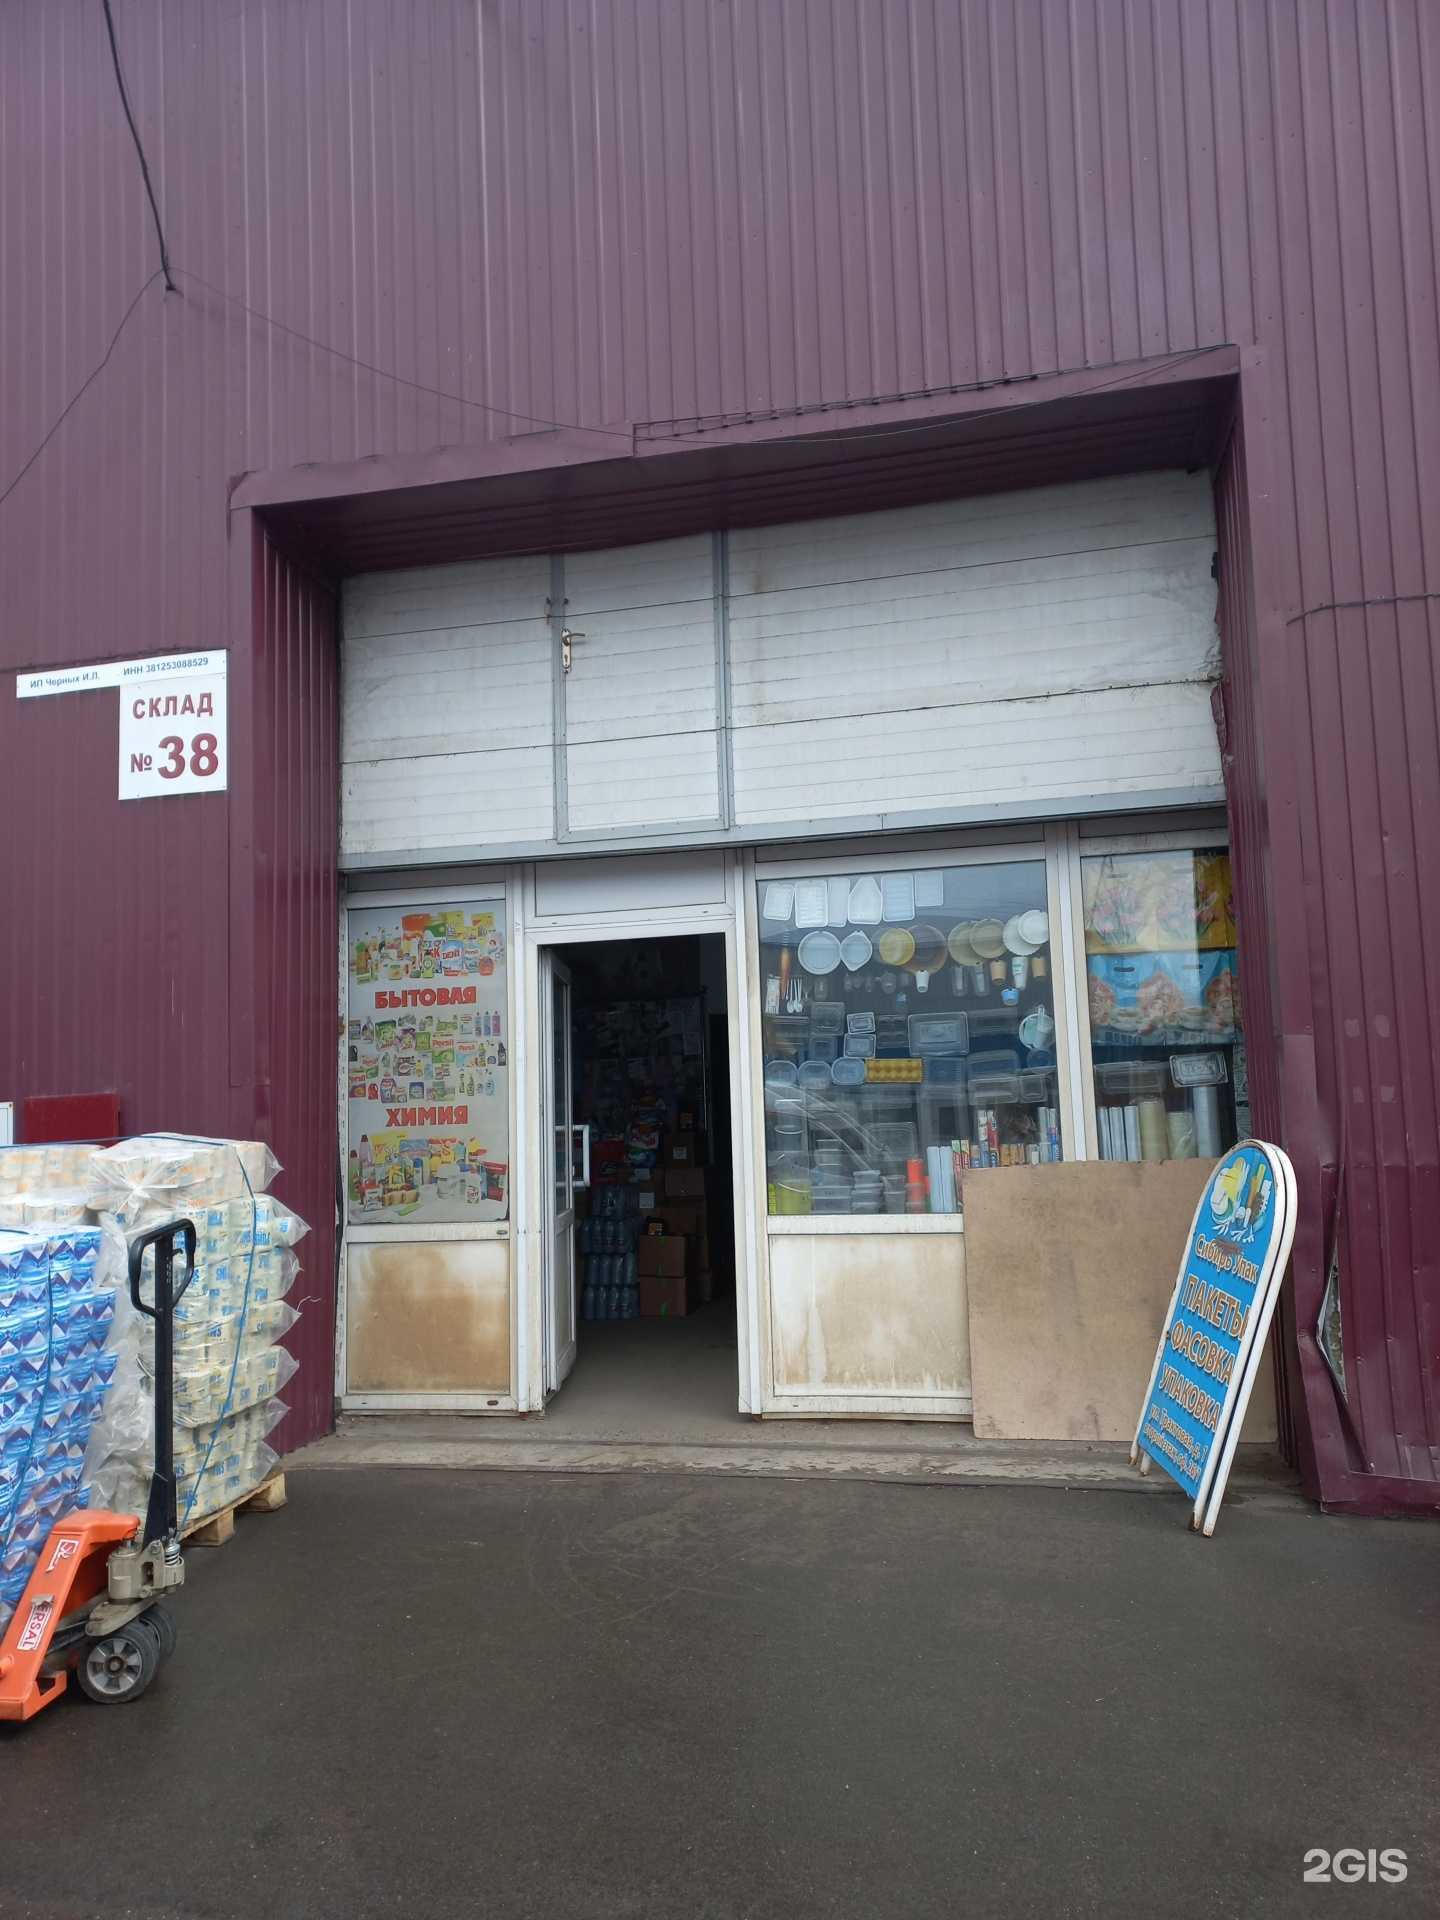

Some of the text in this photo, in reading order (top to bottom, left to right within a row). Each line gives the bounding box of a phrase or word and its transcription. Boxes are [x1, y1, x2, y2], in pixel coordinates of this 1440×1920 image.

[30, 679, 43, 689] ИП
[123, 657, 209, 676] ИНН 381253088529
[132, 692, 213, 719] СКЛАД
[130, 733, 218, 779] № 38
[374, 986, 477, 1009] БЫТОВАЯ
[385, 1105, 469, 1128] ХИМИЯ
[1195, 1233, 1259, 1285] Сибирь Упак
[1182, 1273, 1251, 1341] ПАКЕТЫ
[1171, 1318, 1236, 1387] ФАСОВКА
[1159, 1362, 1221, 1433] УПАКОВКА
